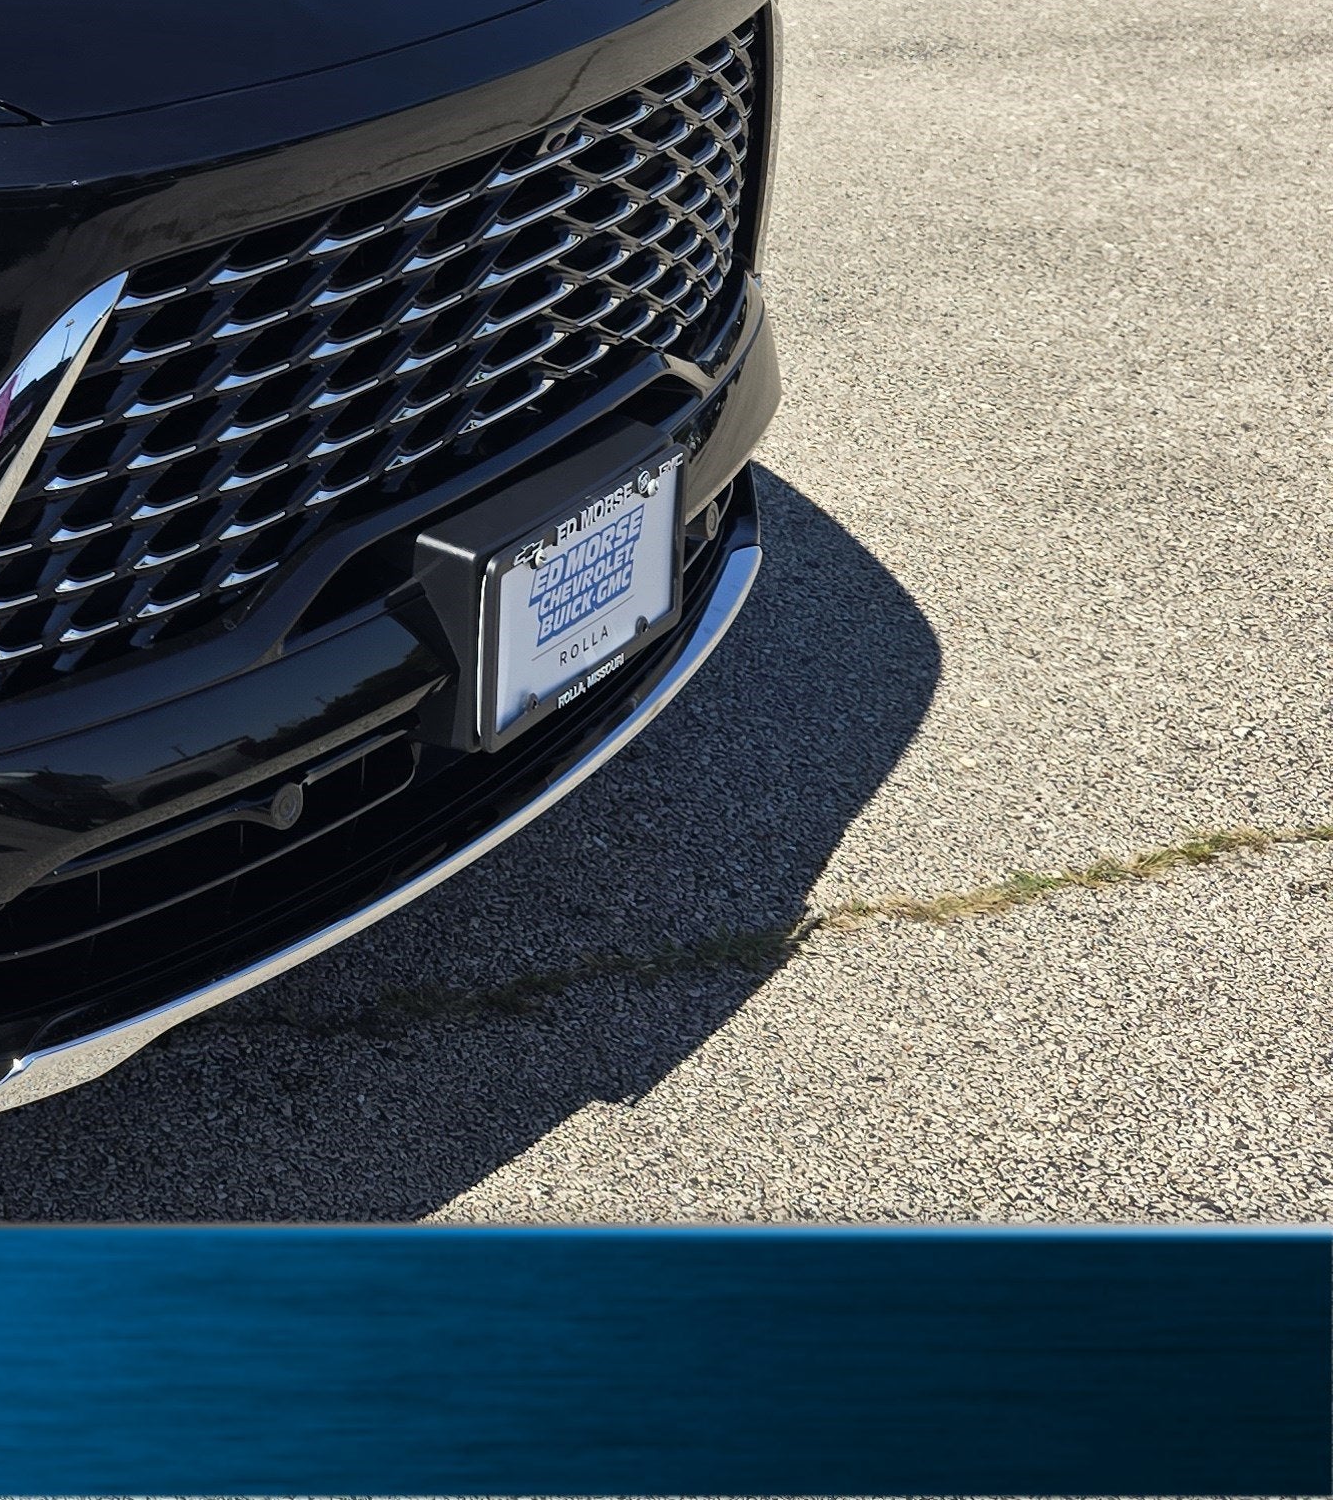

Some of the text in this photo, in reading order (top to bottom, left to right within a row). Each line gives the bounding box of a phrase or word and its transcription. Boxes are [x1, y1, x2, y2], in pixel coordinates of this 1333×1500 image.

[555, 481, 634, 546] ED MORSE
[530, 506, 644, 599] ED MORSE
[539, 539, 635, 617] CHEVROLET
[559, 624, 609, 667] ROLLA
[586, 652, 625, 689] MISSOURI
